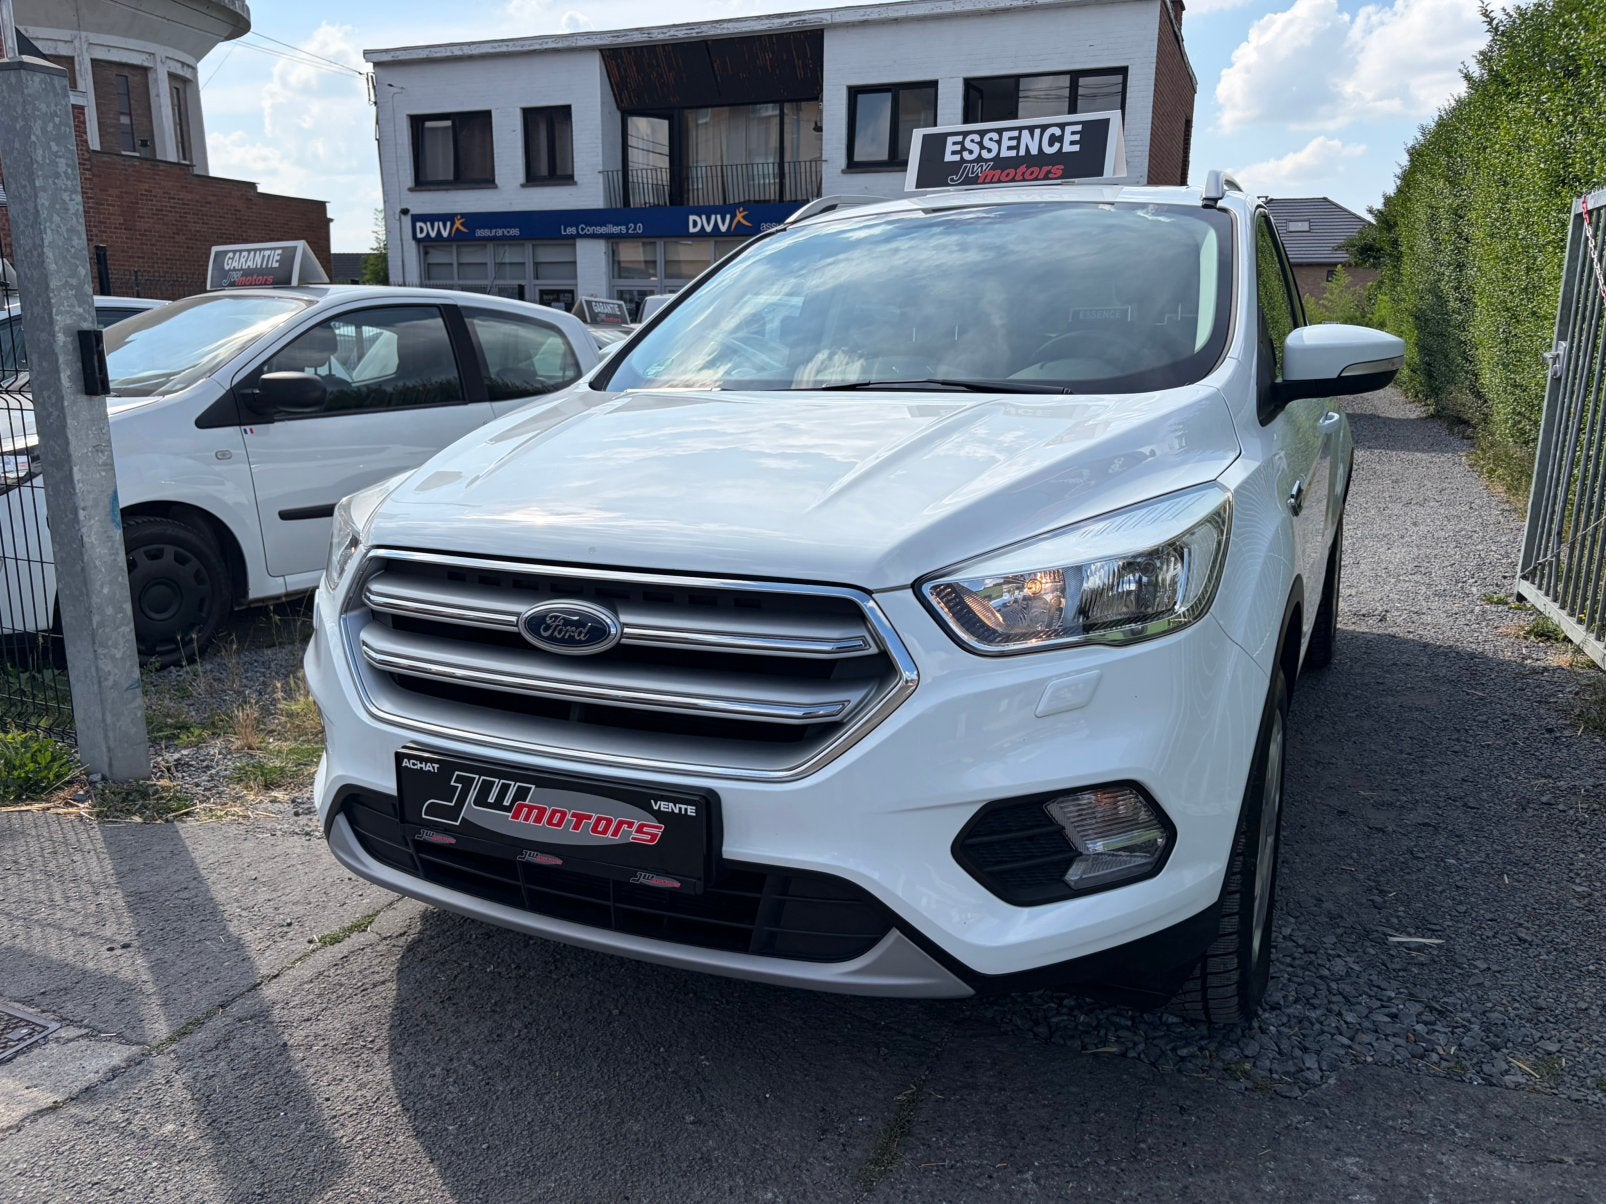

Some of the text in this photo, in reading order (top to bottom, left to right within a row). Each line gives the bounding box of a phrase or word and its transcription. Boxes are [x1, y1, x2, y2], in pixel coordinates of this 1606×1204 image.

[944, 124, 1083, 162] ESSENCE
[977, 163, 1065, 184] motors
[415, 221, 520, 239] DVV assurances
[561, 223, 643, 235] Les Conseillers 2.0
[688, 214, 731, 233] DVV
[224, 250, 282, 270] GARANTIE
[235, 275, 274, 286] motors
[592, 301, 621, 314] GARANTIE
[541, 612, 591, 640] Ford
[402, 758, 440, 773] ACHAT
[422, 771, 536, 825] JW
[650, 800, 696, 816] VENTE
